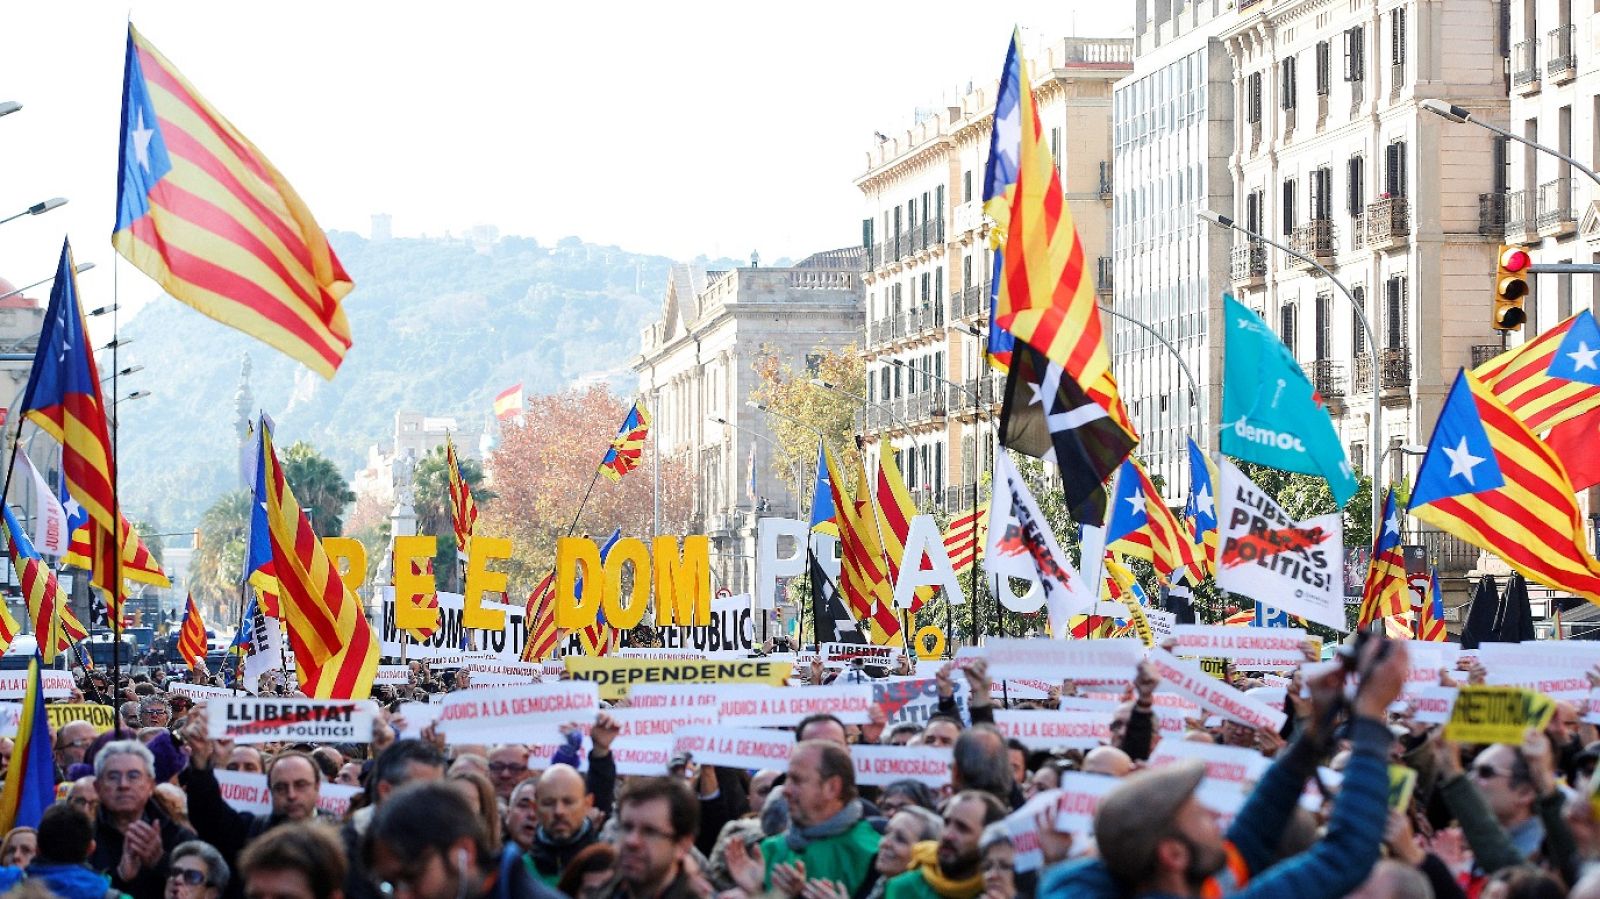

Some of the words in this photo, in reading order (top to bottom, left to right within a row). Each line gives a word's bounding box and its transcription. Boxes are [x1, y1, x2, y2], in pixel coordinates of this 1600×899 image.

[321, 535, 711, 635] REEDOM
[1212, 635, 1219, 647] A
[572, 662, 771, 684] NDEPENDENCE
[8, 679, 20, 691] LA
[22, 675, 74, 691] DOCRÀCIA
[481, 701, 490, 716] A
[493, 700, 508, 715] LA
[511, 691, 594, 712] DEMOCRÀCIA
[760, 700, 769, 714] A
[771, 699, 787, 714] LA
[227, 703, 355, 722] LLIBERTAT
[286, 723, 355, 738] POLÍTICS!
[857, 758, 872, 773] LA
